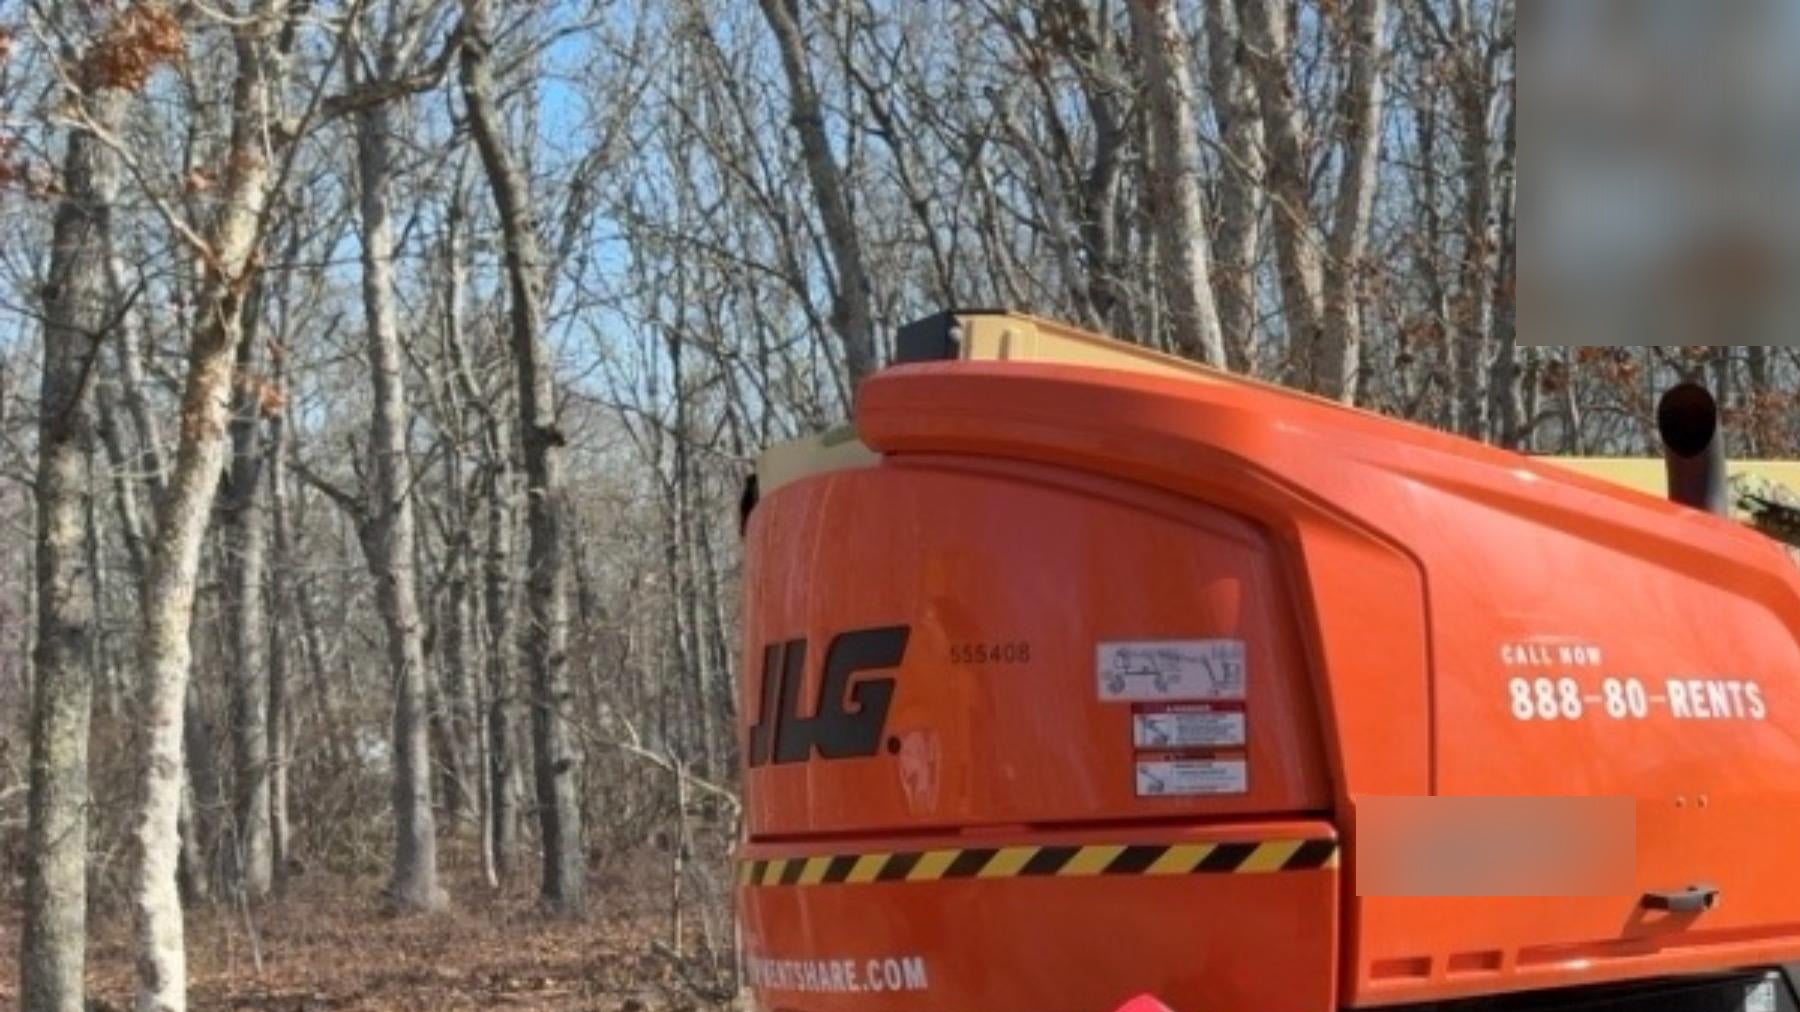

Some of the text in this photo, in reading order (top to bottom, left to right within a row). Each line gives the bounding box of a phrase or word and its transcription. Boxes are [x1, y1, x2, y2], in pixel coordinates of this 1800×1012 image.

[950, 641, 1031, 665] 555408
[1501, 643, 1602, 666] CALL NOW
[1508, 676, 1767, 721] 888-80-RENTS
